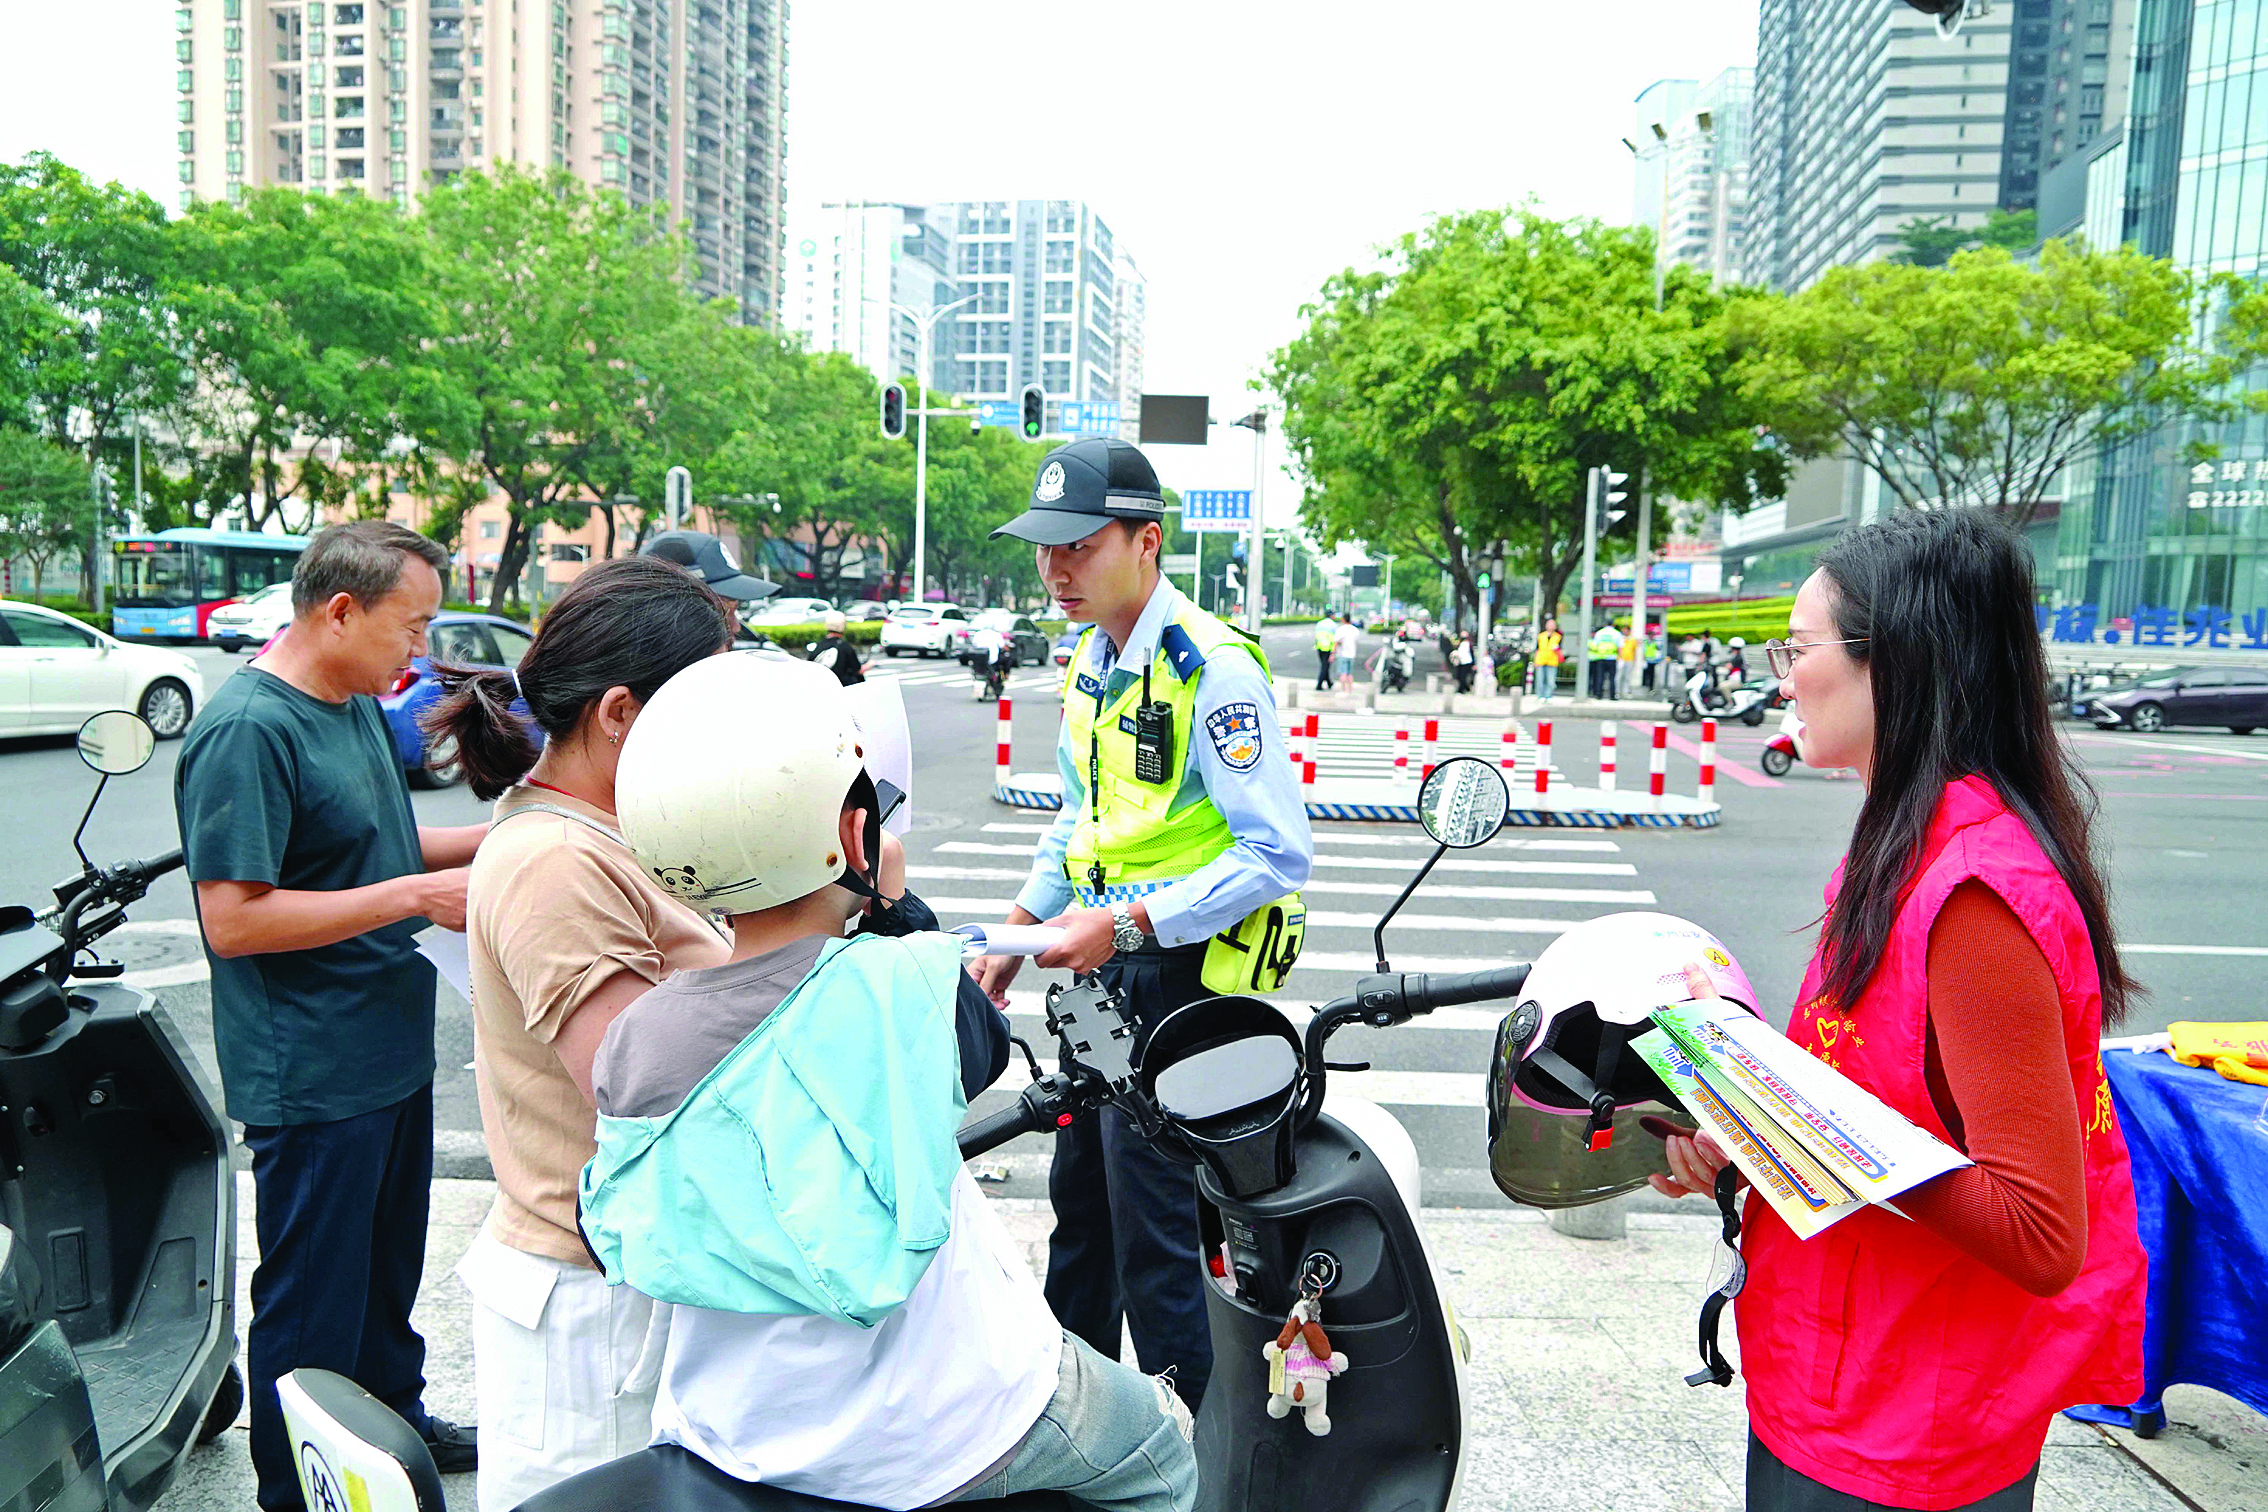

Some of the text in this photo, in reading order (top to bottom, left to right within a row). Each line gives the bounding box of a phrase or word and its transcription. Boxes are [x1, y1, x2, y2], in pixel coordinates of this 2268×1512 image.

[2211, 490, 2268, 508] 2222
[1740, 1142, 1796, 1202] 法规牢记心
